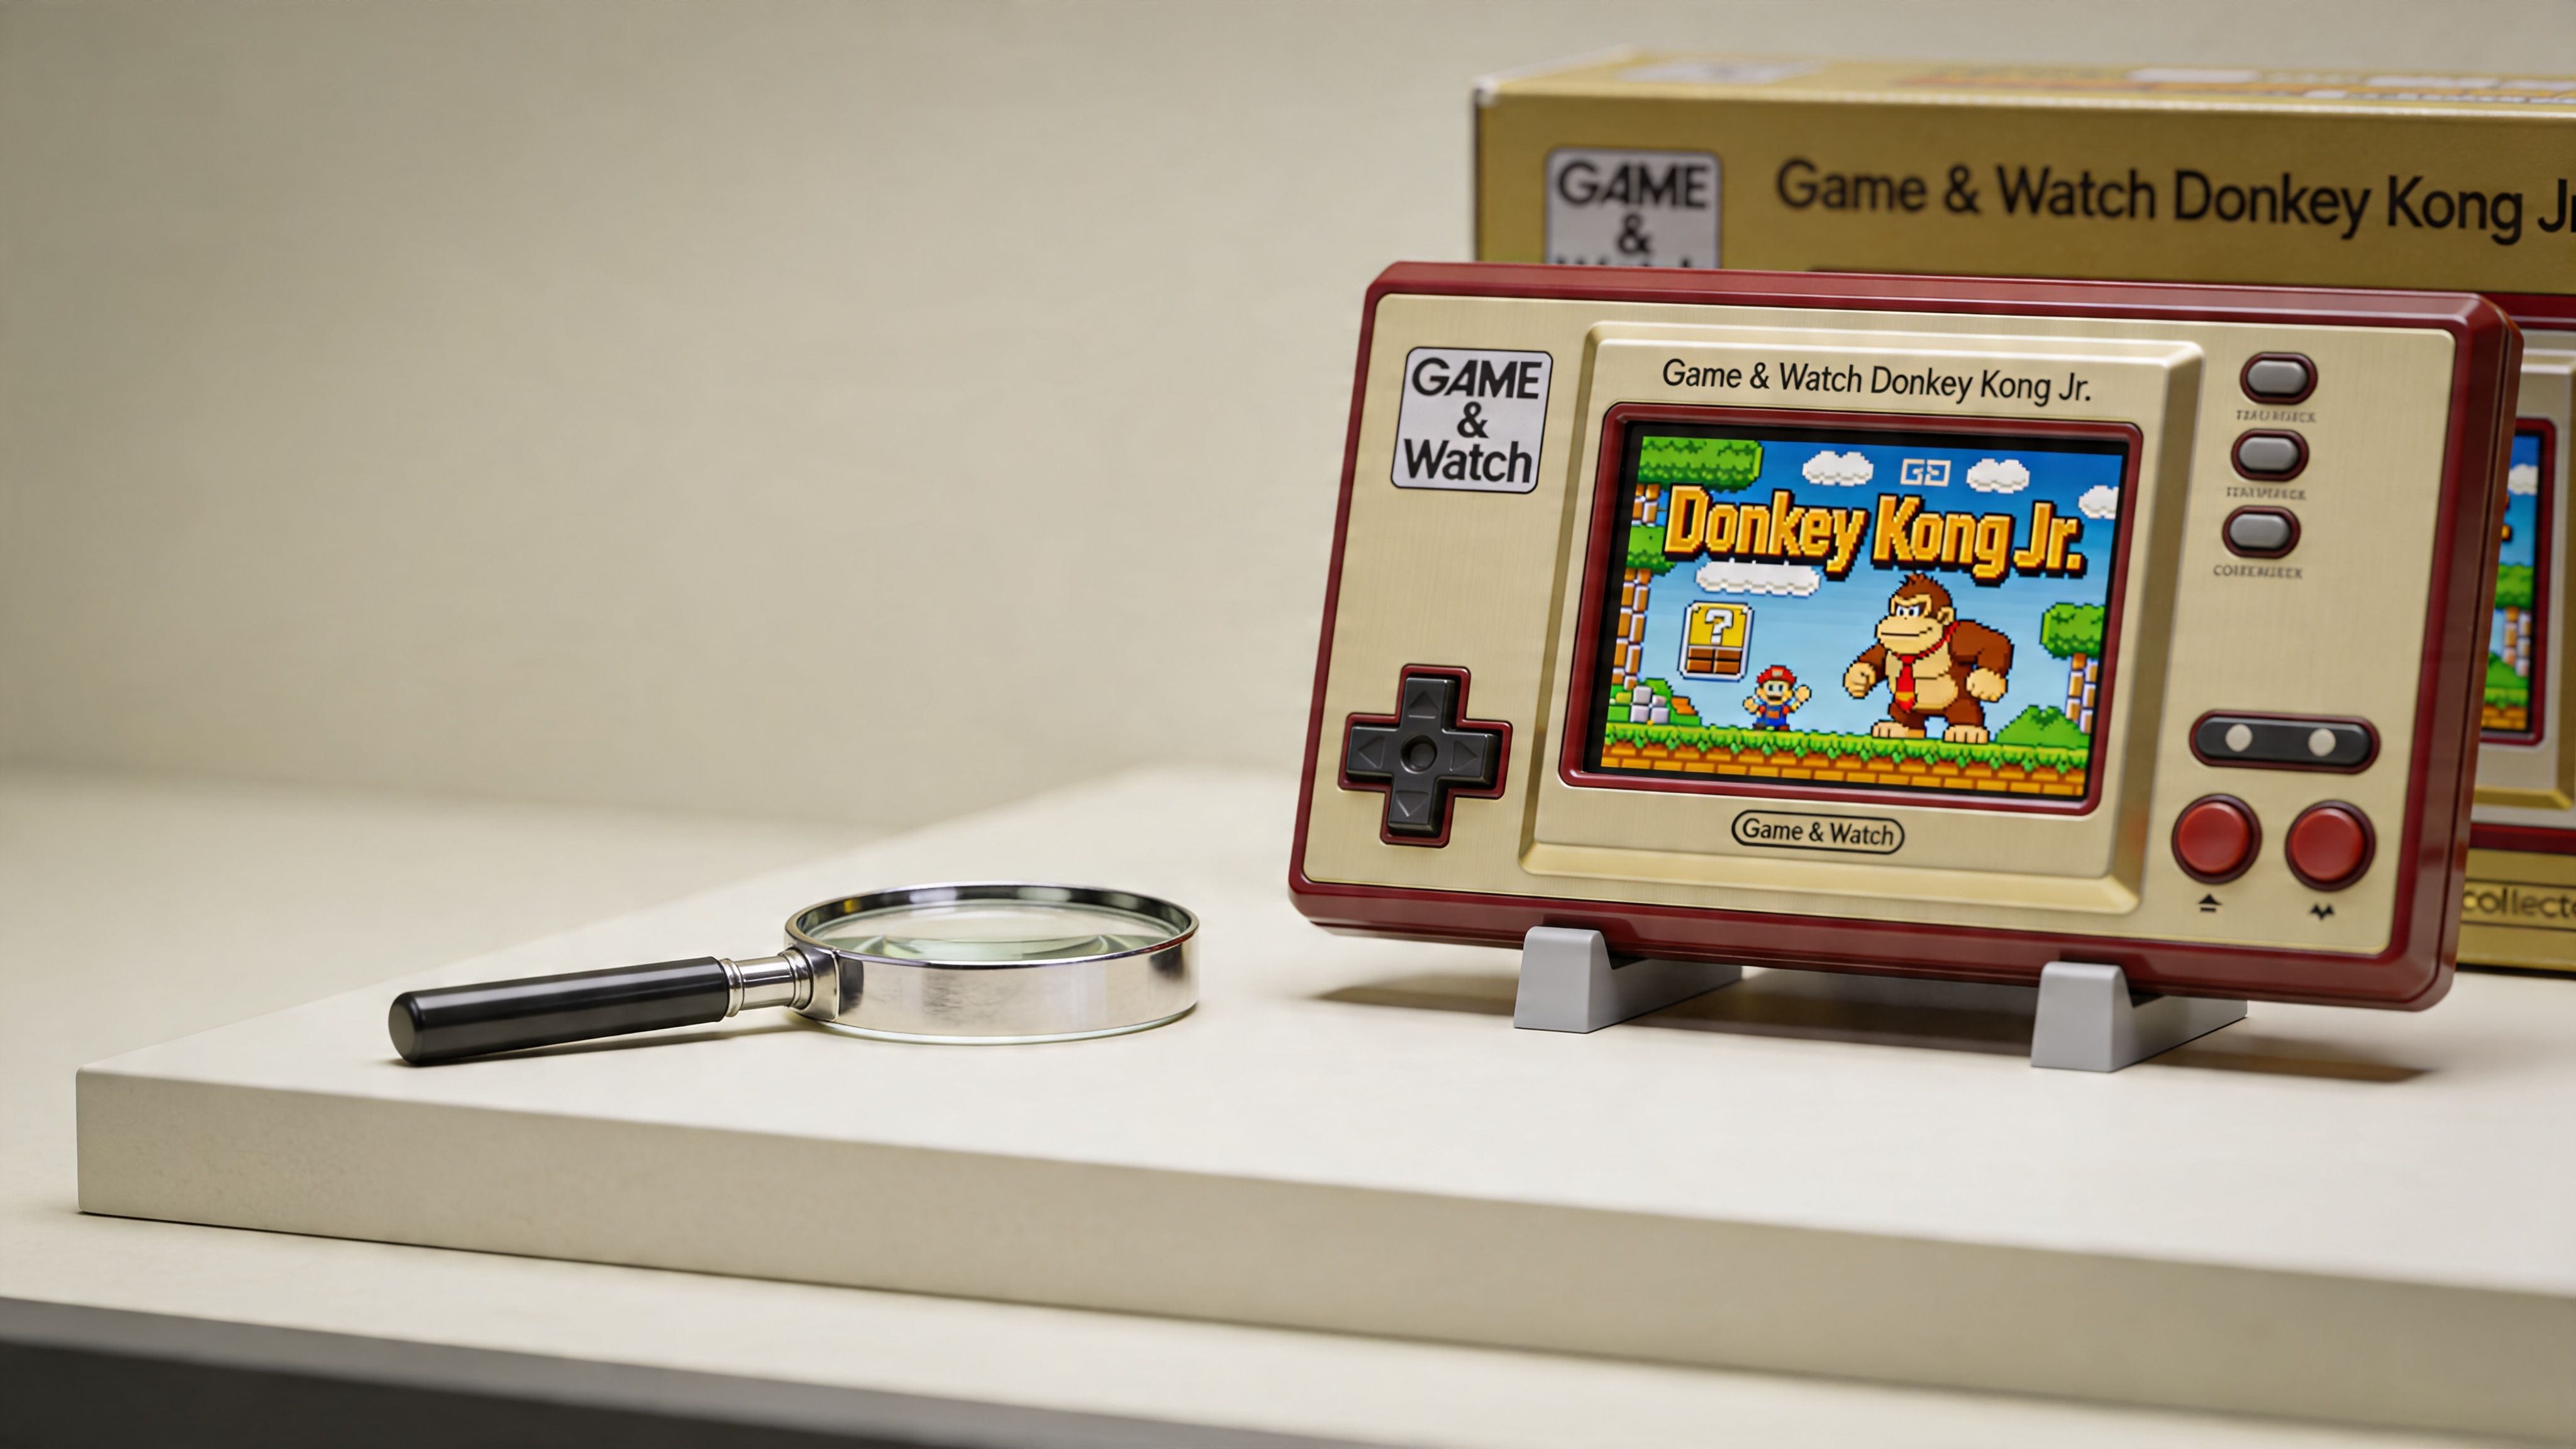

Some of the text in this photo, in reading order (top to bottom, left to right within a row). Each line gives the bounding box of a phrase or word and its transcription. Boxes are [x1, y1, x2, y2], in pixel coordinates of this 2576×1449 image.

[1557, 160, 1708, 209] GAME
[1775, 155, 1928, 213] Game
[1943, 164, 1981, 215] &
[1996, 164, 2157, 220] Watch
[2174, 169, 2372, 241] Donkey
[2387, 175, 2523, 247] Kong
[1616, 213, 1652, 255] &
[1411, 357, 1543, 399] GAME
[1662, 358, 2092, 408] Game & Watch Donkey Kong Jr.
[1457, 401, 1489, 438] &
[1403, 438, 1533, 483] Watch
[1663, 484, 2085, 583] Donkey Kong Jr.
[1704, 608, 1734, 645] ?
[1742, 818, 1894, 846] Game & Watch
